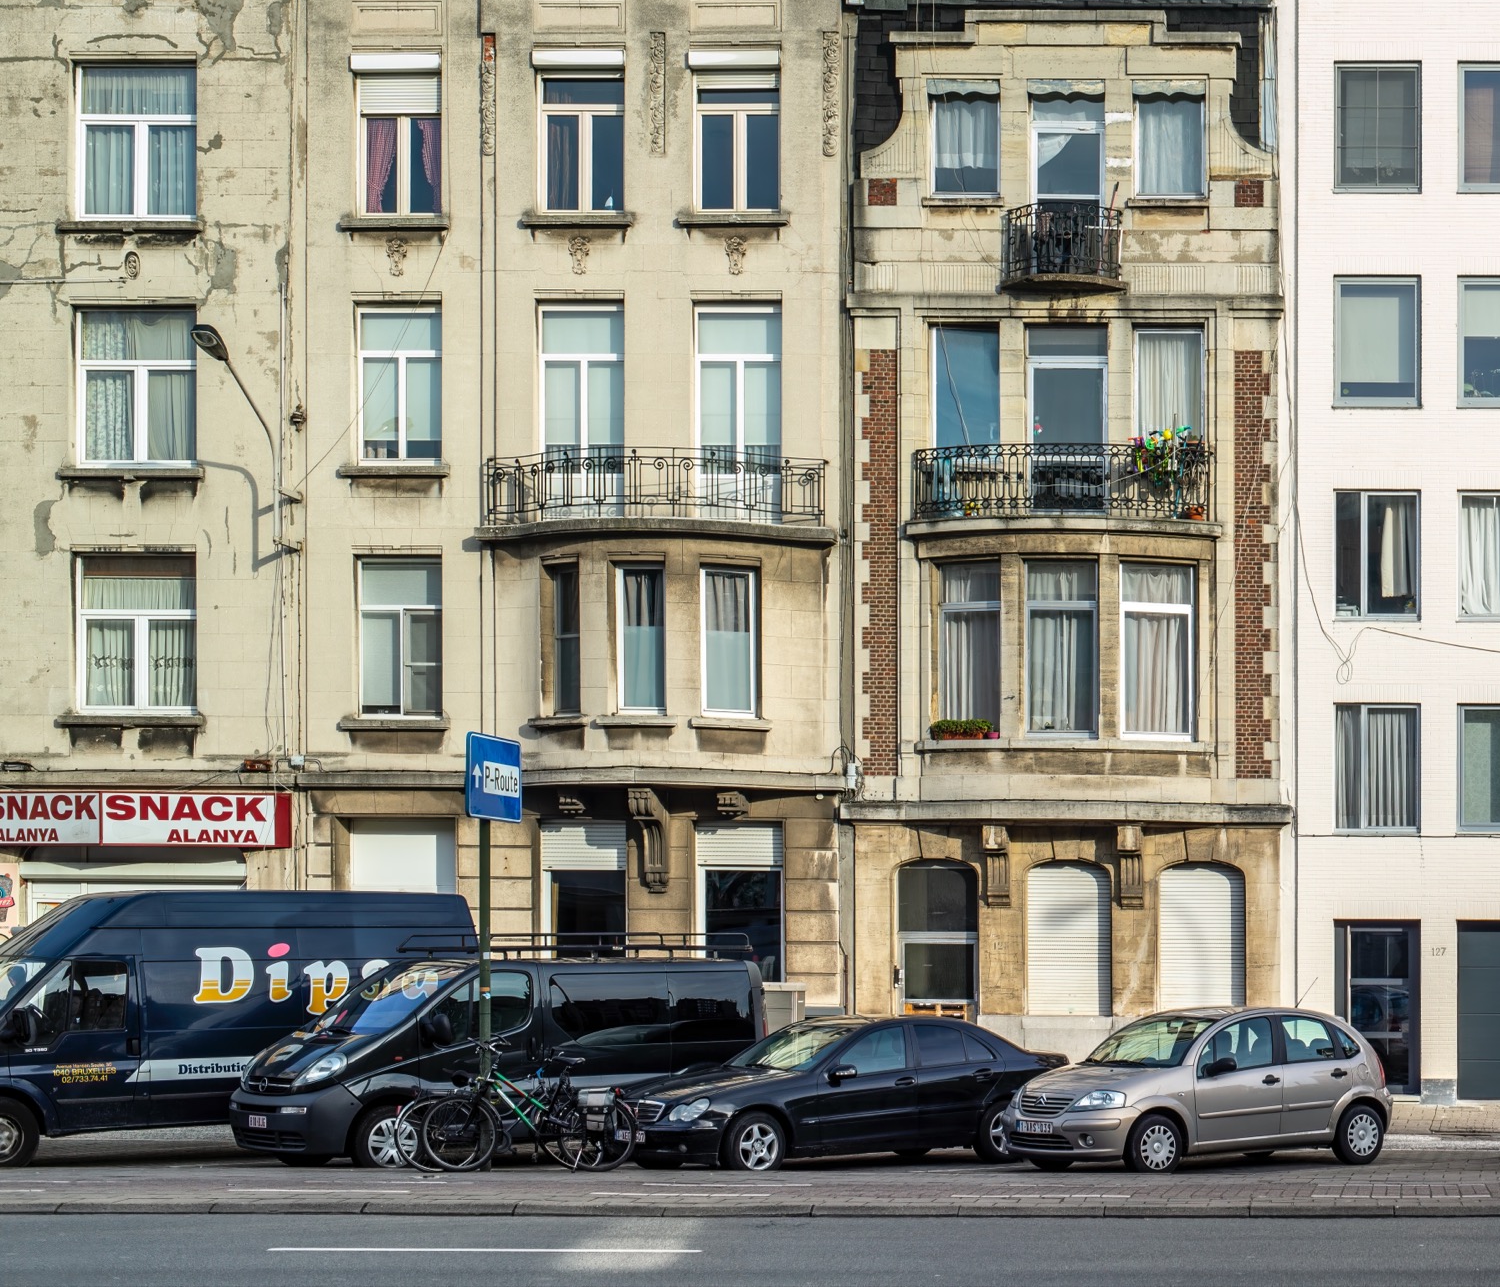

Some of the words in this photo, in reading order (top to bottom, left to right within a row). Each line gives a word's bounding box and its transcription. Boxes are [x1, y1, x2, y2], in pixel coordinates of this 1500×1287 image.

[485, 765, 518, 793] P-Route
[0, 795, 97, 820] NACK
[105, 795, 267, 821] SNACK
[167, 829, 259, 843] ALANYA
[1431, 947, 1446, 956] 127
[71, 1067, 116, 1075] BRUXELLES
[178, 1062, 248, 1074] Distributio
[62, 1075, 108, 1083] 02/733.74.41
